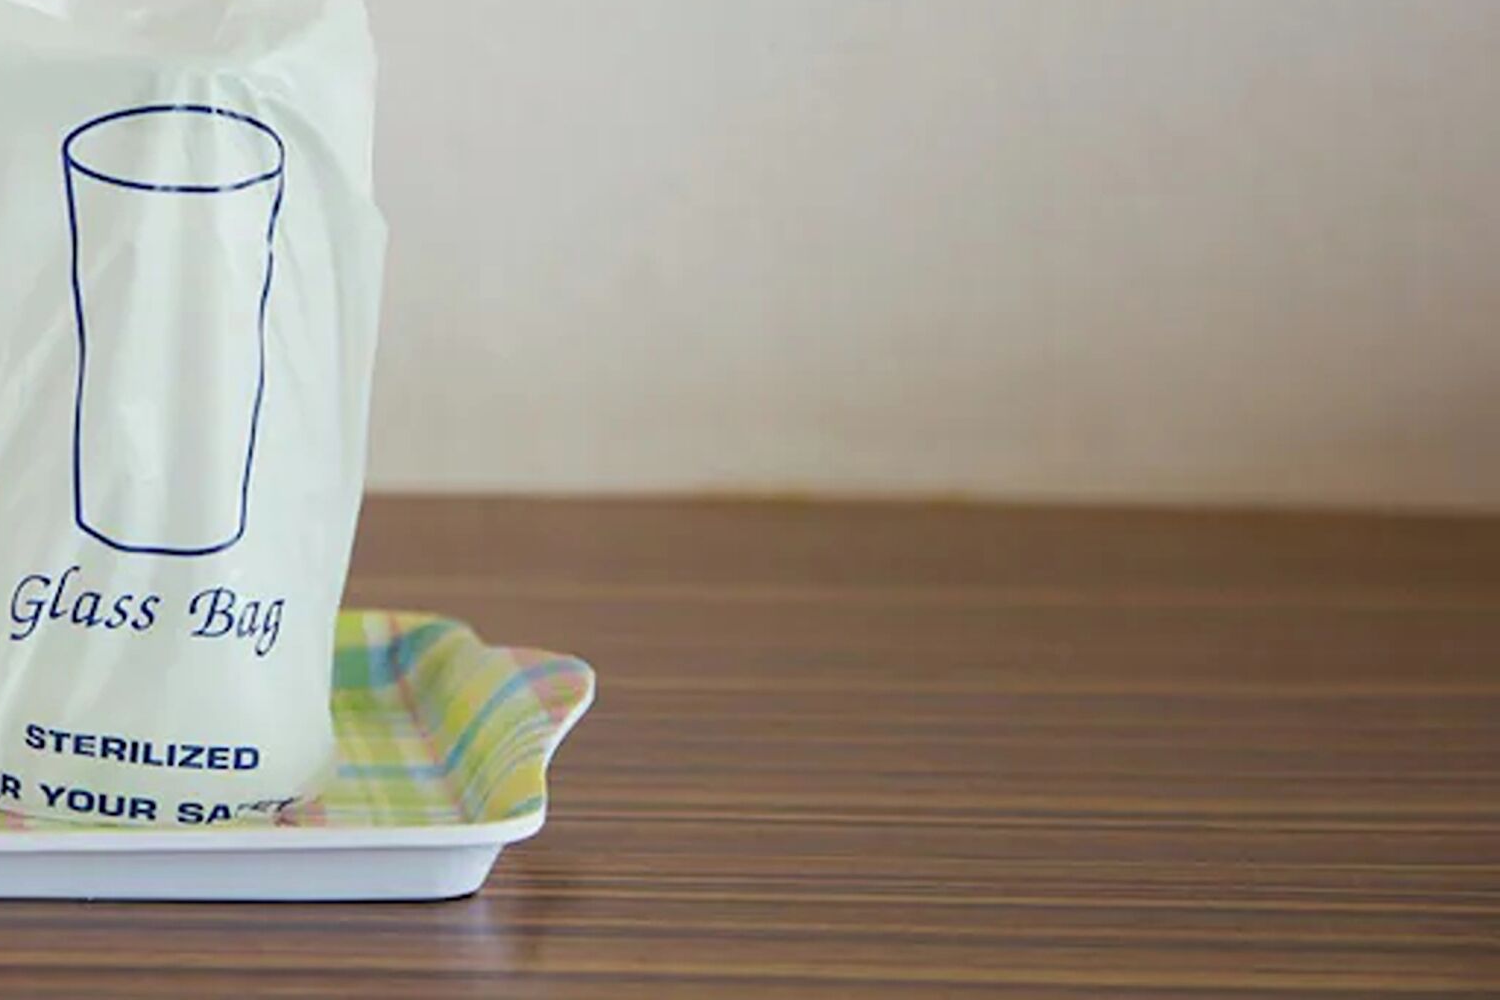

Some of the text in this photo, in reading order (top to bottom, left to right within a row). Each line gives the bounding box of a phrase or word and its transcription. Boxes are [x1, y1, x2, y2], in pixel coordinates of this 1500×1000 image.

[9, 564, 286, 657] Glass Bag
[24, 723, 260, 772] STERILIZED
[38, 783, 157, 821] YOUR
